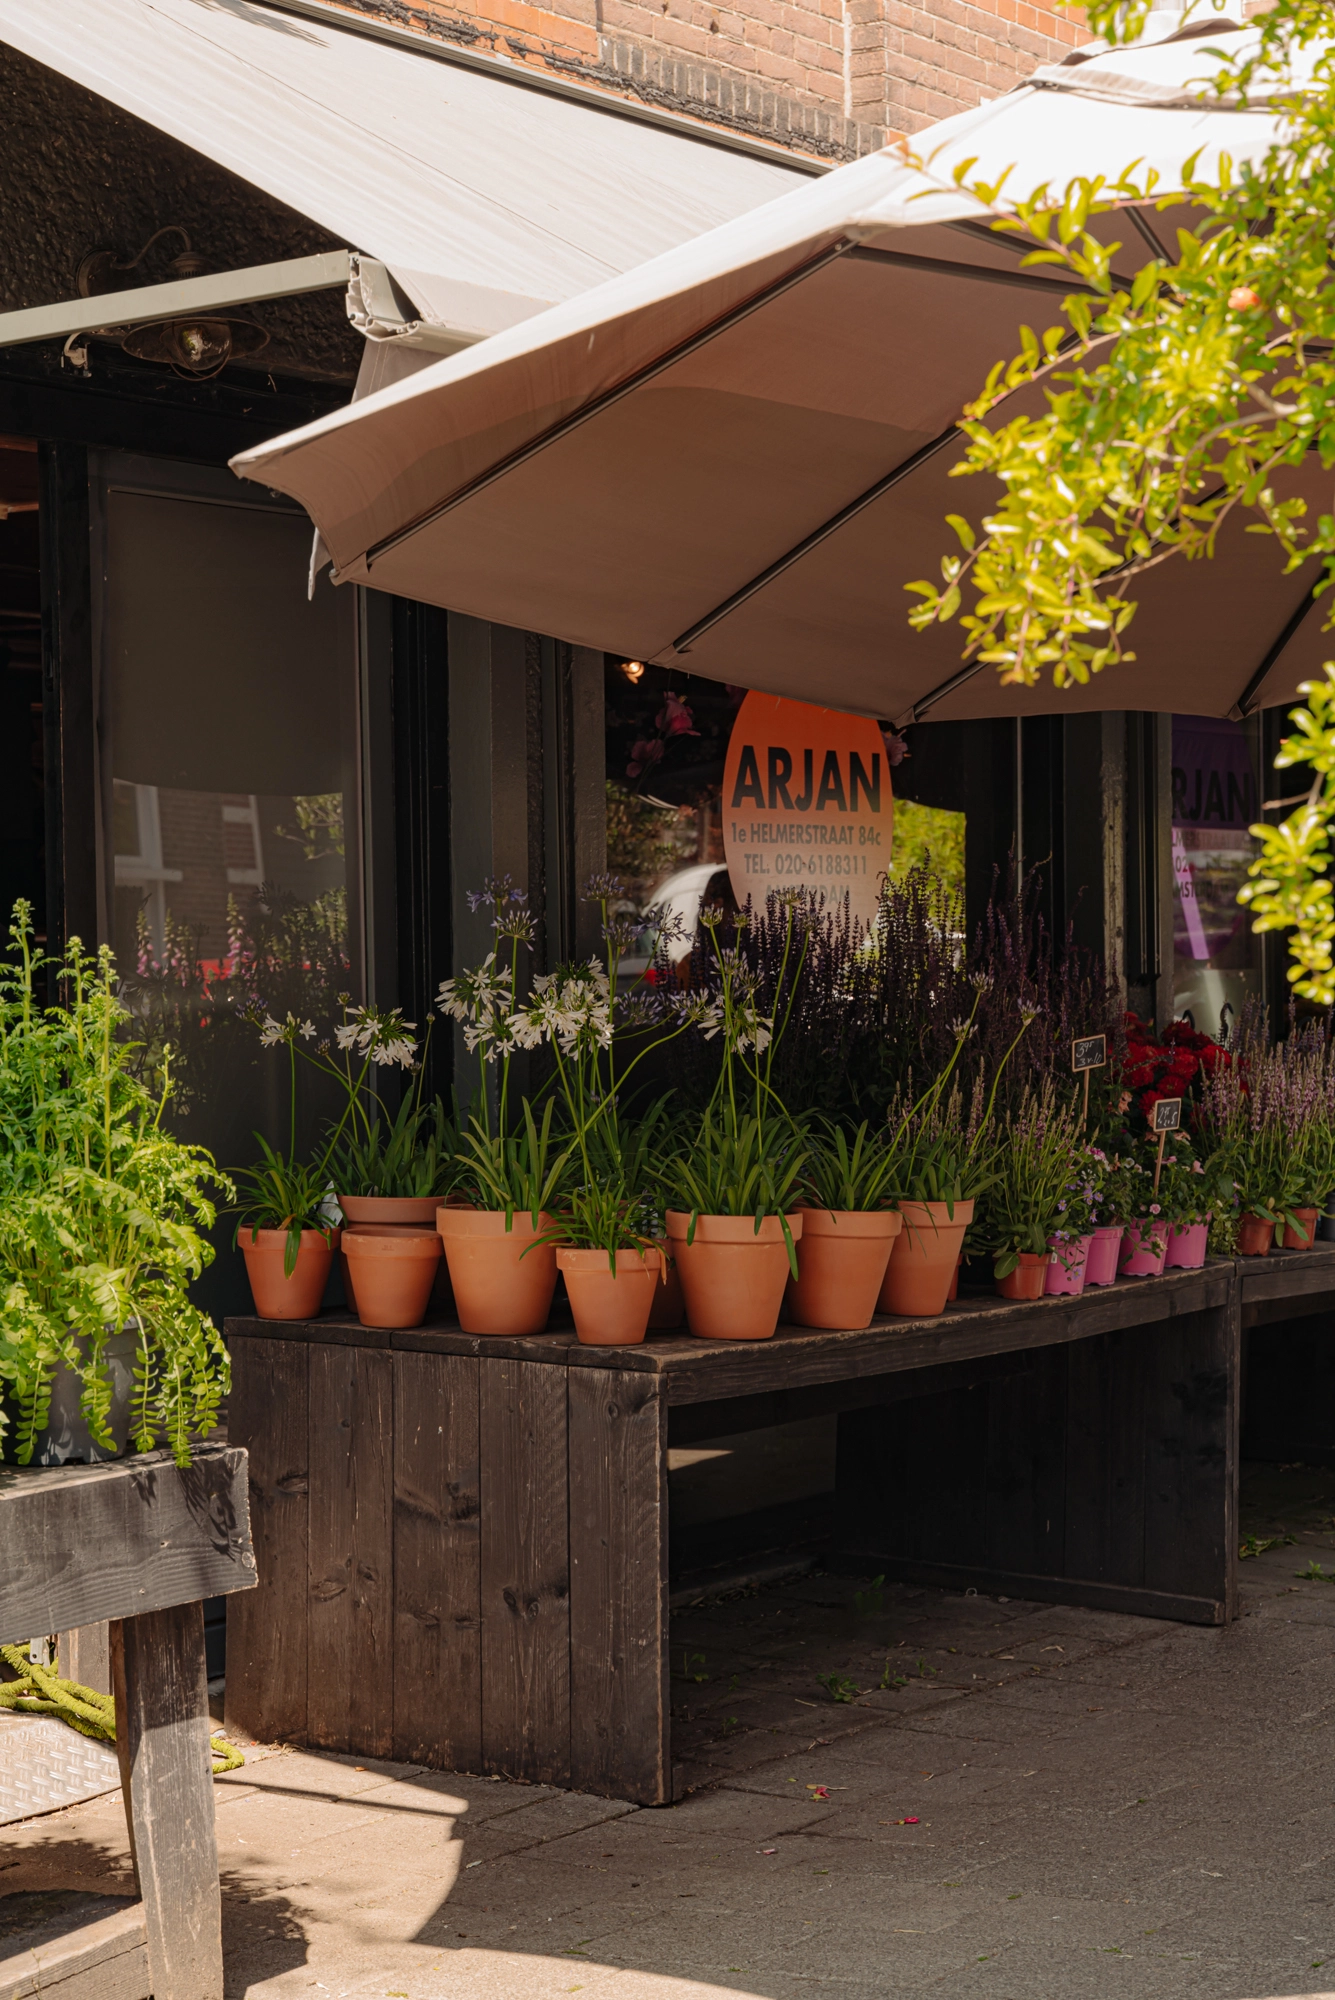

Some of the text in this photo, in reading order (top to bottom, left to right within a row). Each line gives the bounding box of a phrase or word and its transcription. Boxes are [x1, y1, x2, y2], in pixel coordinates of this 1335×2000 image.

[731, 745, 881, 813] ARJAN
[731, 822, 881, 846] 1e HELMERSTRAAT 84c
[775, 855, 867, 876] 020-6188311
